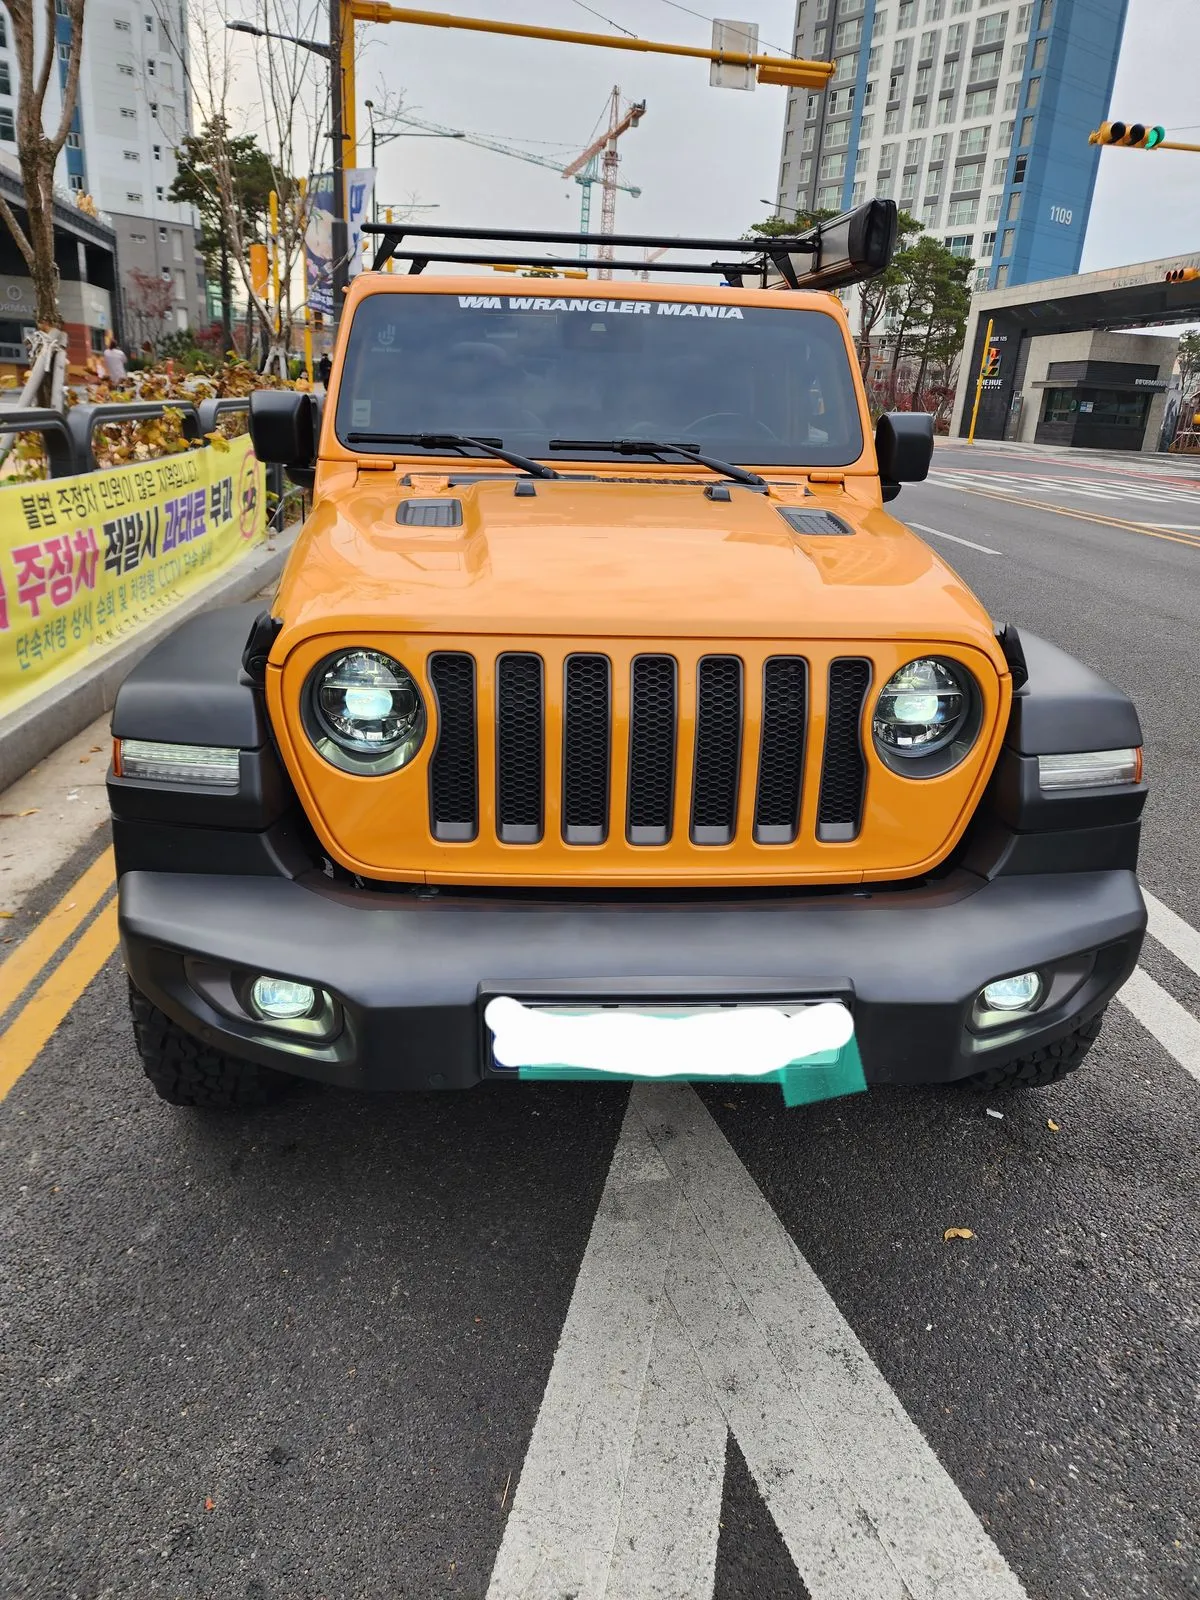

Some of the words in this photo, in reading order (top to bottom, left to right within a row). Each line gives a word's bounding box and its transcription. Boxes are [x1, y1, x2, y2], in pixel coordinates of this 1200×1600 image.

[1050, 206, 1072, 225] 1109
[509, 297, 651, 314] WRANGLER
[657, 303, 744, 320] MANIA
[21, 491, 57, 530] 불법
[56, 483, 98, 521] 주정차
[98, 473, 134, 510] 민원이
[134, 469, 157, 500] 많은
[11, 527, 100, 618] 주정차
[102, 505, 160, 577] 적발시
[162, 488, 207, 554] 과태료
[210, 476, 233, 528] 부과
[15, 615, 67, 671] 단속차량
[71, 601, 94, 640] 상시
